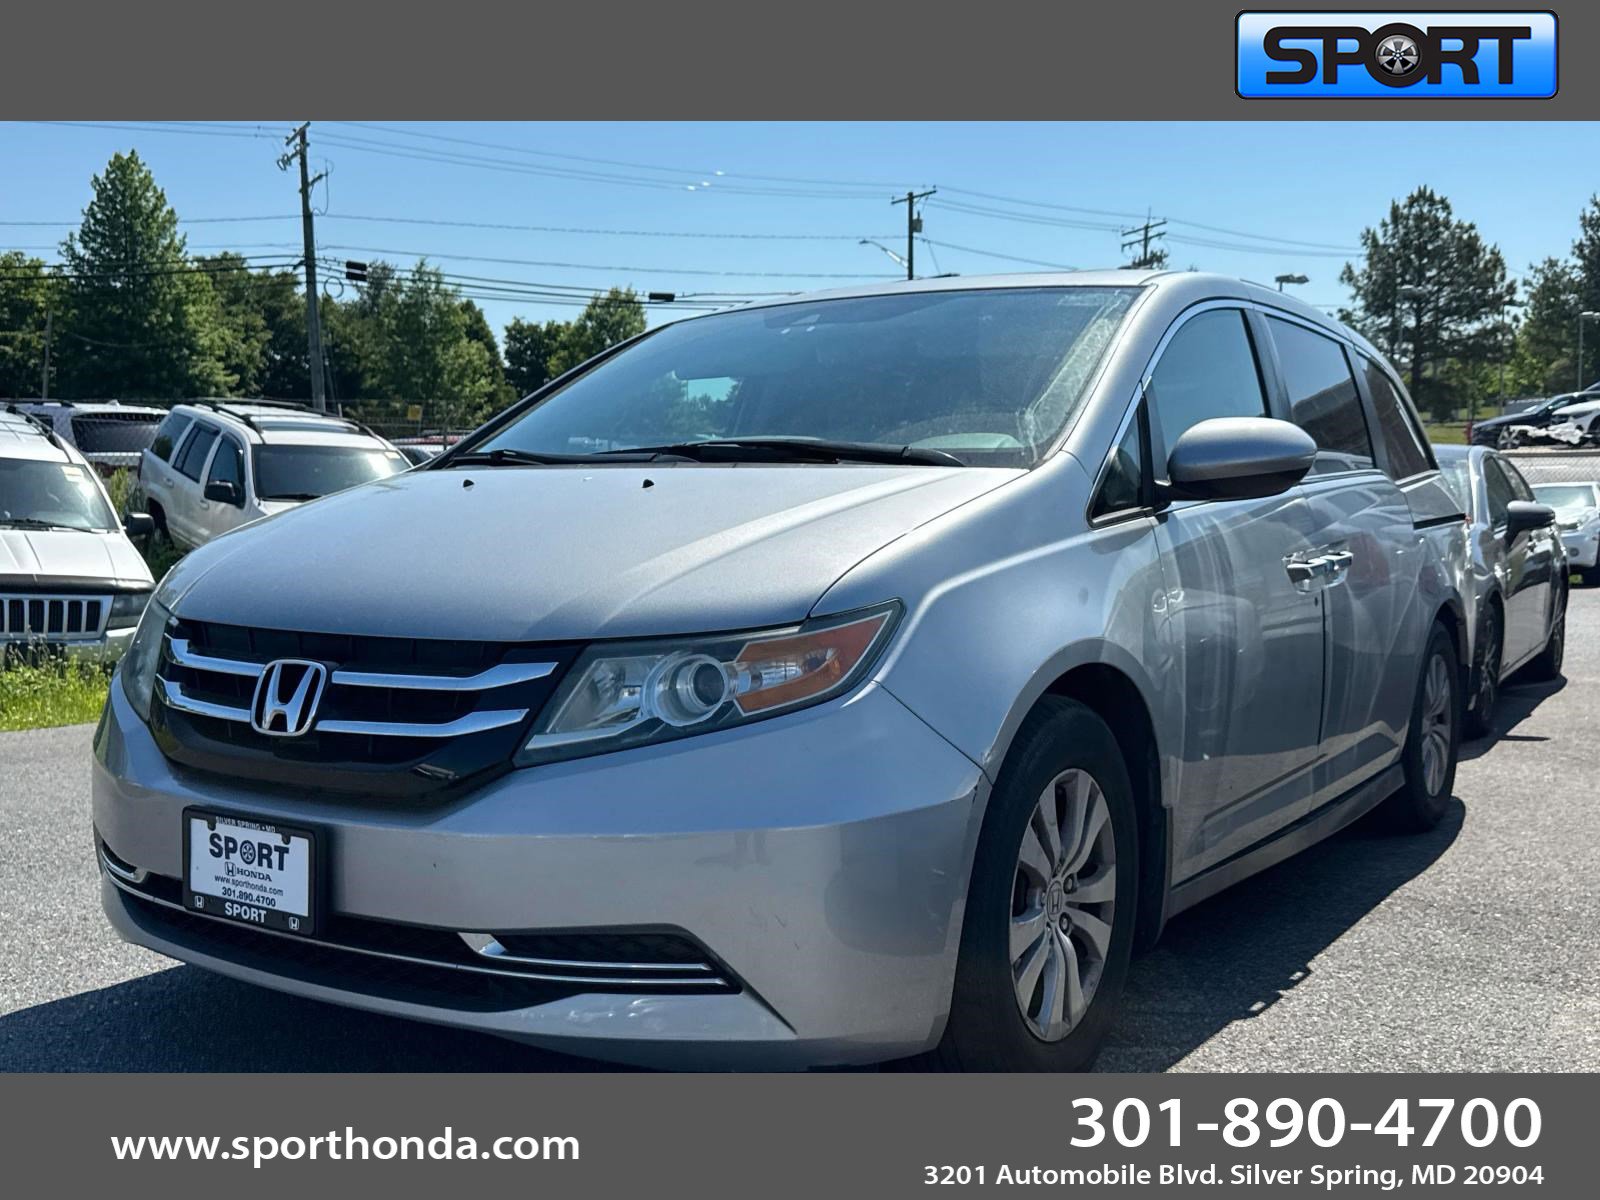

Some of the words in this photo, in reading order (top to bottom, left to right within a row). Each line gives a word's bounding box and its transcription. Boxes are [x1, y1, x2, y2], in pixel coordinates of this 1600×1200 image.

[215, 816, 236, 827] SILVER
[237, 820, 261, 831] SPRING
[208, 832, 290, 871] SPORT
[236, 867, 272, 882] HONDA
[214, 875, 284, 897] www.sporthonda.com
[222, 886, 276, 908] 301.890.4700
[224, 901, 267, 923] SPORT
